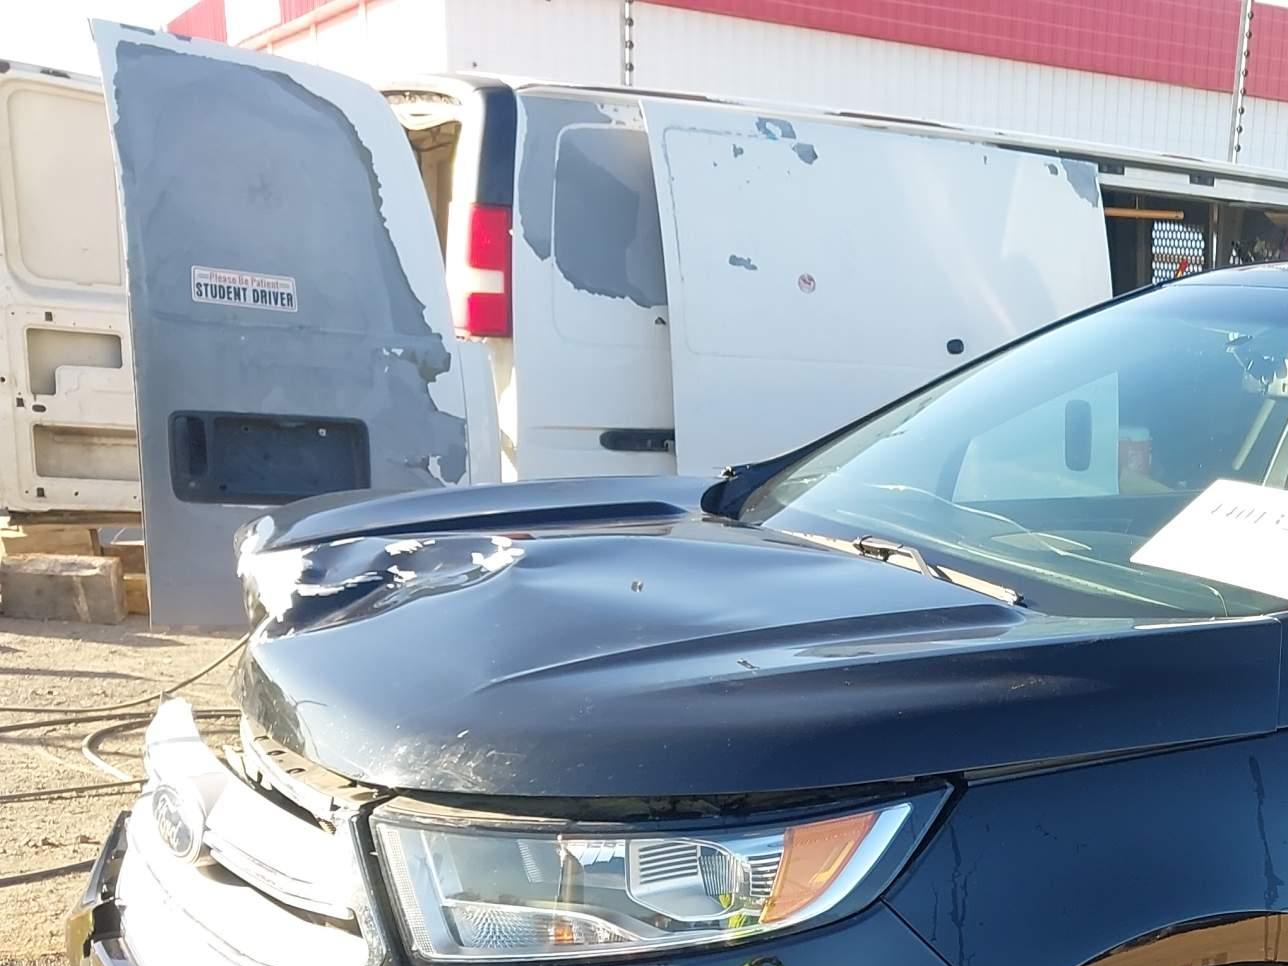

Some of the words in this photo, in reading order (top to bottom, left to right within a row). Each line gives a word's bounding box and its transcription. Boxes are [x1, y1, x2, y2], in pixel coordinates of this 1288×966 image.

[209, 271, 237, 284] Please
[238, 276, 249, 285] Be
[251, 278, 279, 289] Patient
[195, 282, 247, 303] STUDENT
[252, 288, 294, 308] DRIVER
[155, 793, 182, 848] Ford
